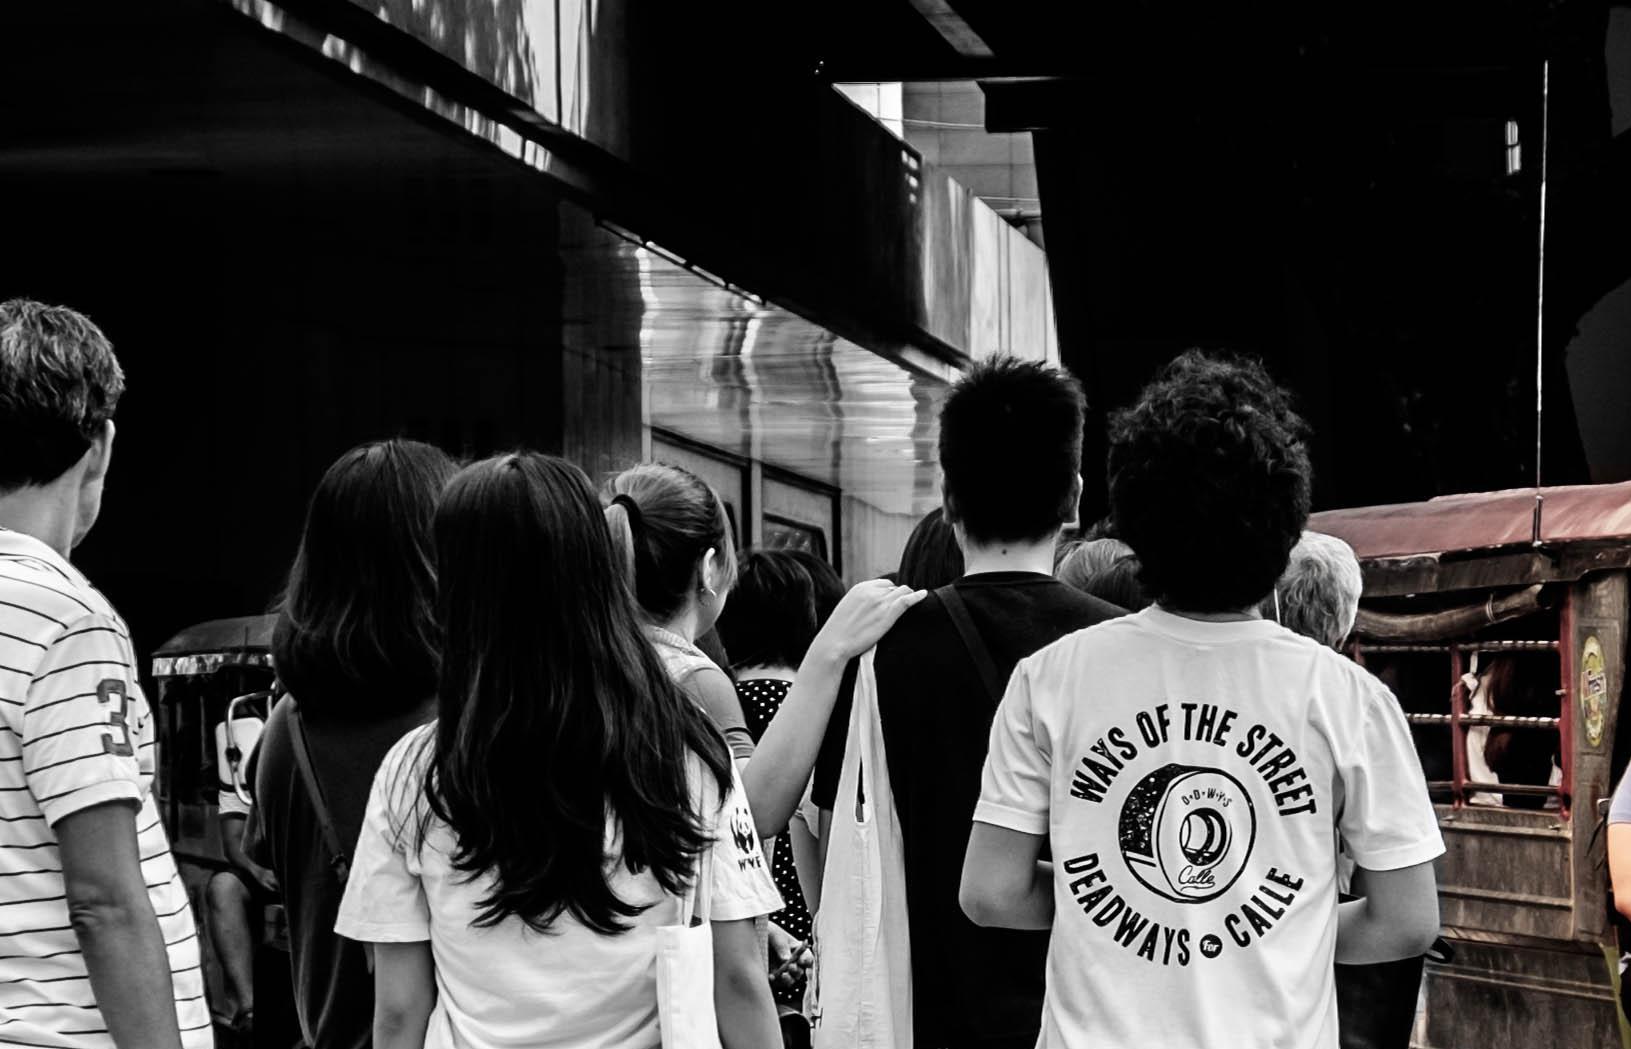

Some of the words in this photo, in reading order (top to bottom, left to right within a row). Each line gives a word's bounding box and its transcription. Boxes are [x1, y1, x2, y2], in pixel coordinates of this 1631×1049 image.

[96, 678, 133, 757] 3
[1070, 727, 1138, 803] WAYS
[1136, 704, 1170, 748] OF
[1181, 703, 1238, 747] THE
[1236, 724, 1317, 816] STREET
[1063, 852, 1190, 966] DEADWAYS
[1224, 867, 1305, 948] CALLE
[1178, 865, 1216, 884] Calle
